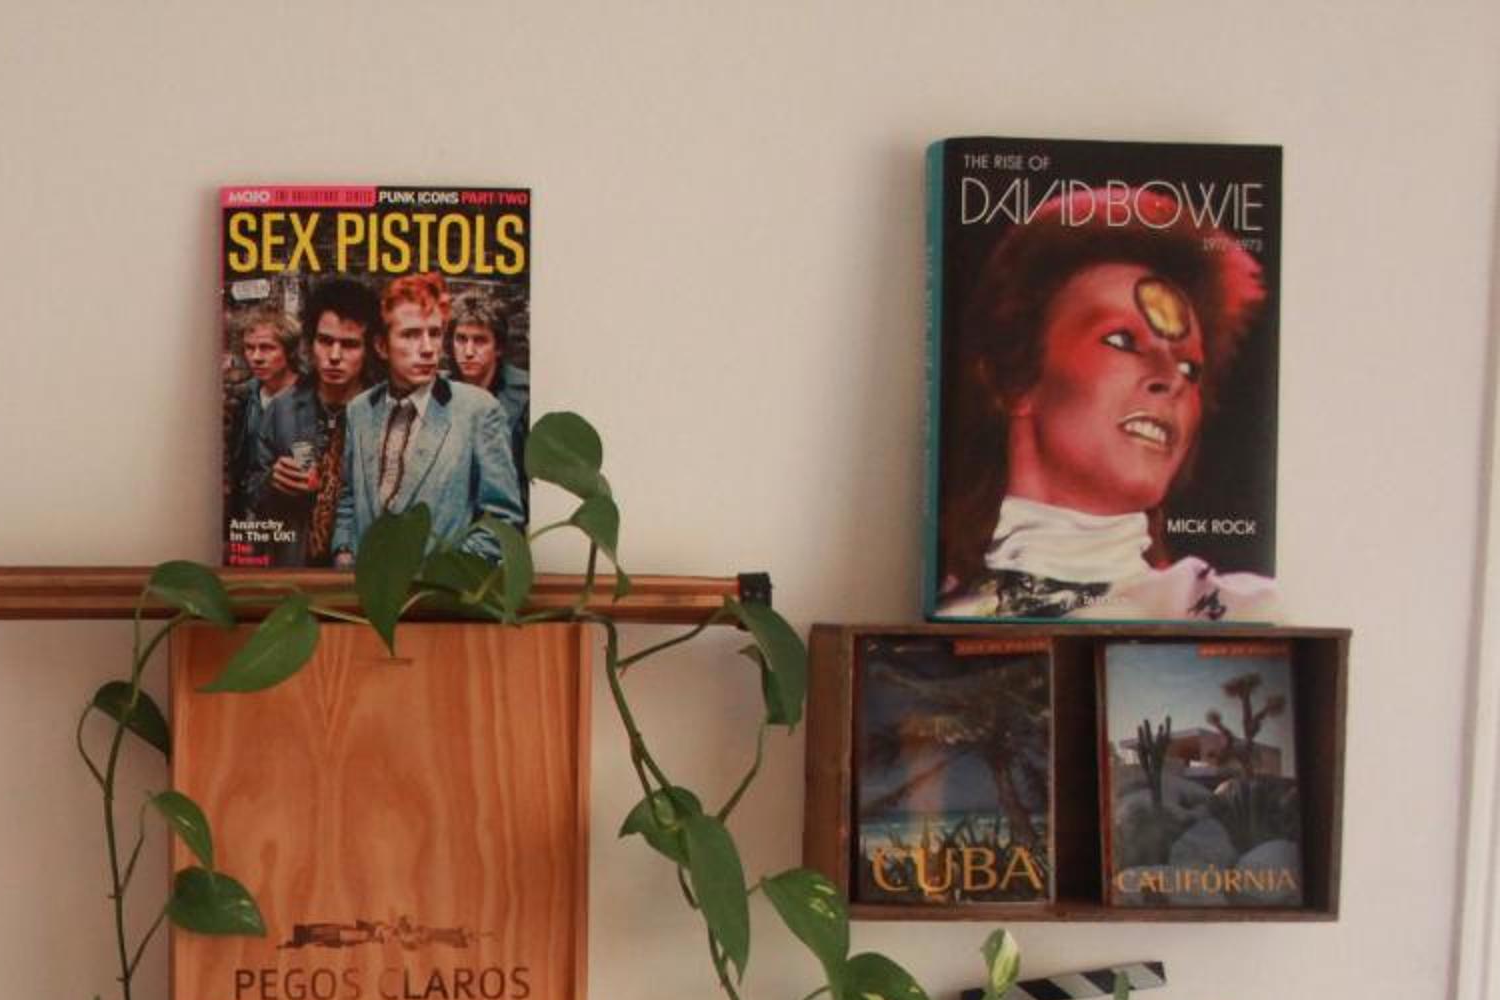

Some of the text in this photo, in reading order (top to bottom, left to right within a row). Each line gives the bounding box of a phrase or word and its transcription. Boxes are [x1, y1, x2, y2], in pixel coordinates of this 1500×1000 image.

[964, 154, 1051, 171] THE RISE OF
[379, 191, 415, 204] PUNK
[418, 192, 459, 204] ICONS
[461, 192, 496, 205] PART
[499, 192, 528, 205] TWO
[960, 177, 1264, 231] DAVID BOWIE
[227, 211, 526, 275] SEX PISTOLS
[230, 519, 283, 531] Anarchy
[1167, 519, 1257, 535] MICK ROCK
[248, 531, 269, 542] The
[871, 846, 1045, 895] CUBA
